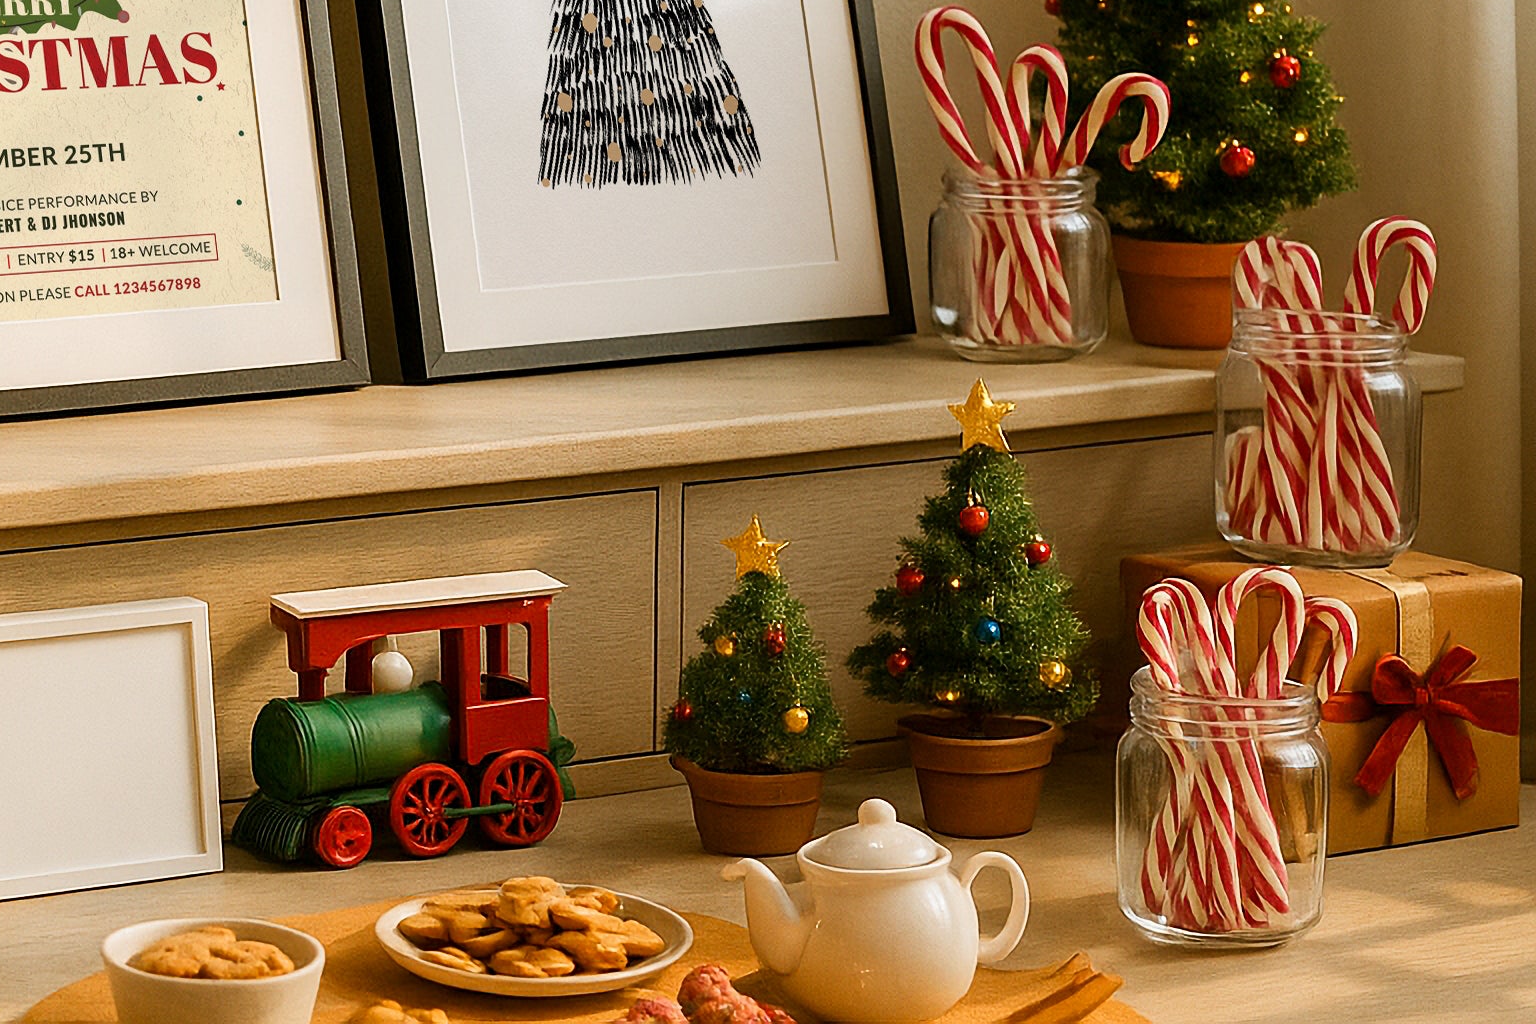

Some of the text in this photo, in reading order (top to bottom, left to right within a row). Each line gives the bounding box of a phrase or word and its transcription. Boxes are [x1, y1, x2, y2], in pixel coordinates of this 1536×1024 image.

[65, 142, 126, 165] 25TH
[29, 192, 136, 210] PERFORMANCE
[141, 190, 159, 203] BY
[27, 216, 37, 231] &
[41, 214, 58, 231] DJ
[62, 211, 125, 229] JHONSON
[18, 251, 64, 266] ENTRY
[68, 249, 95, 264] $15
[109, 247, 136, 260] 18+
[138, 241, 211, 257] WELCOME
[19, 286, 72, 302] PLEASE
[74, 283, 110, 298] CALL
[114, 277, 200, 295] 1234567898
